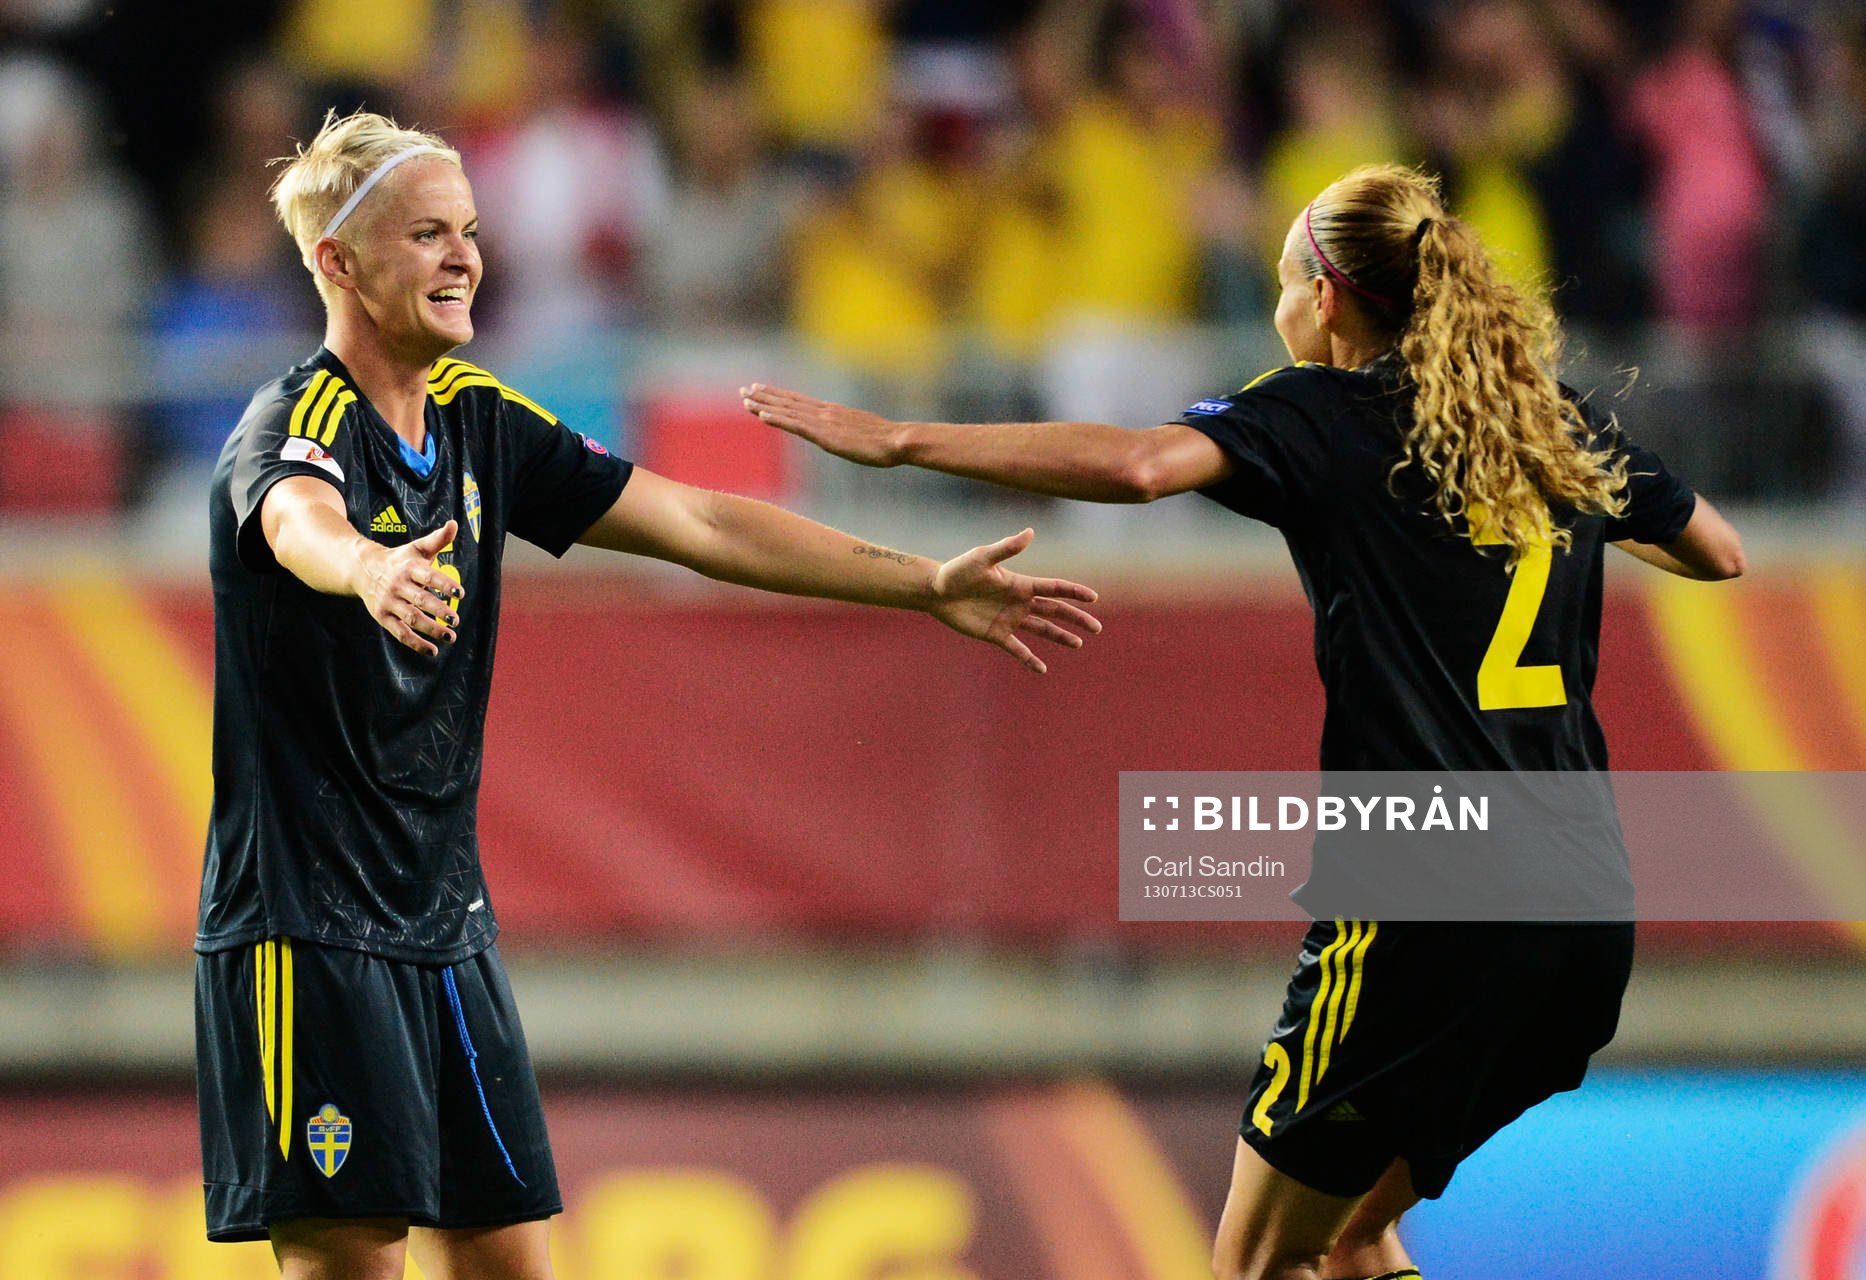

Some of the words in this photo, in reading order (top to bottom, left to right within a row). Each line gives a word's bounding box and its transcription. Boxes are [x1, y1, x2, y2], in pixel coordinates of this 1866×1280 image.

[370, 522, 407, 533] adidas
[1467, 498, 1567, 710] 2
[1252, 1042, 1291, 1136] 2
